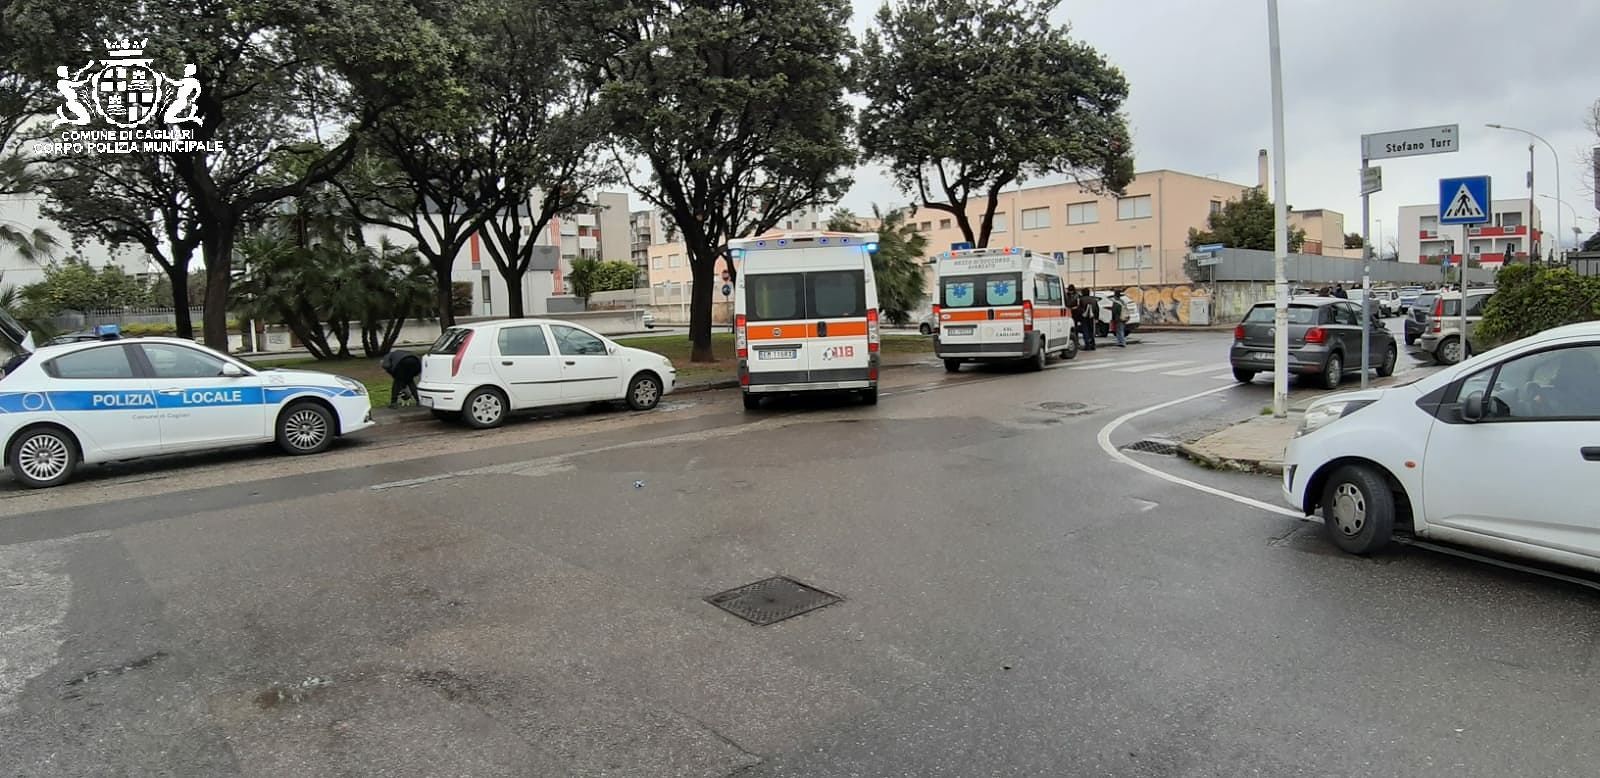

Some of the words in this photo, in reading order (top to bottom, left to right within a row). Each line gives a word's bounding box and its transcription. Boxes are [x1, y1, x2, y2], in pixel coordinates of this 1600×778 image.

[1385, 141, 1425, 153] Stefano
[832, 345, 854, 357] 118
[93, 394, 154, 406] POLIZIA
[183, 390, 242, 404] LOCALE
[167, 412, 191, 420] Cagliari
